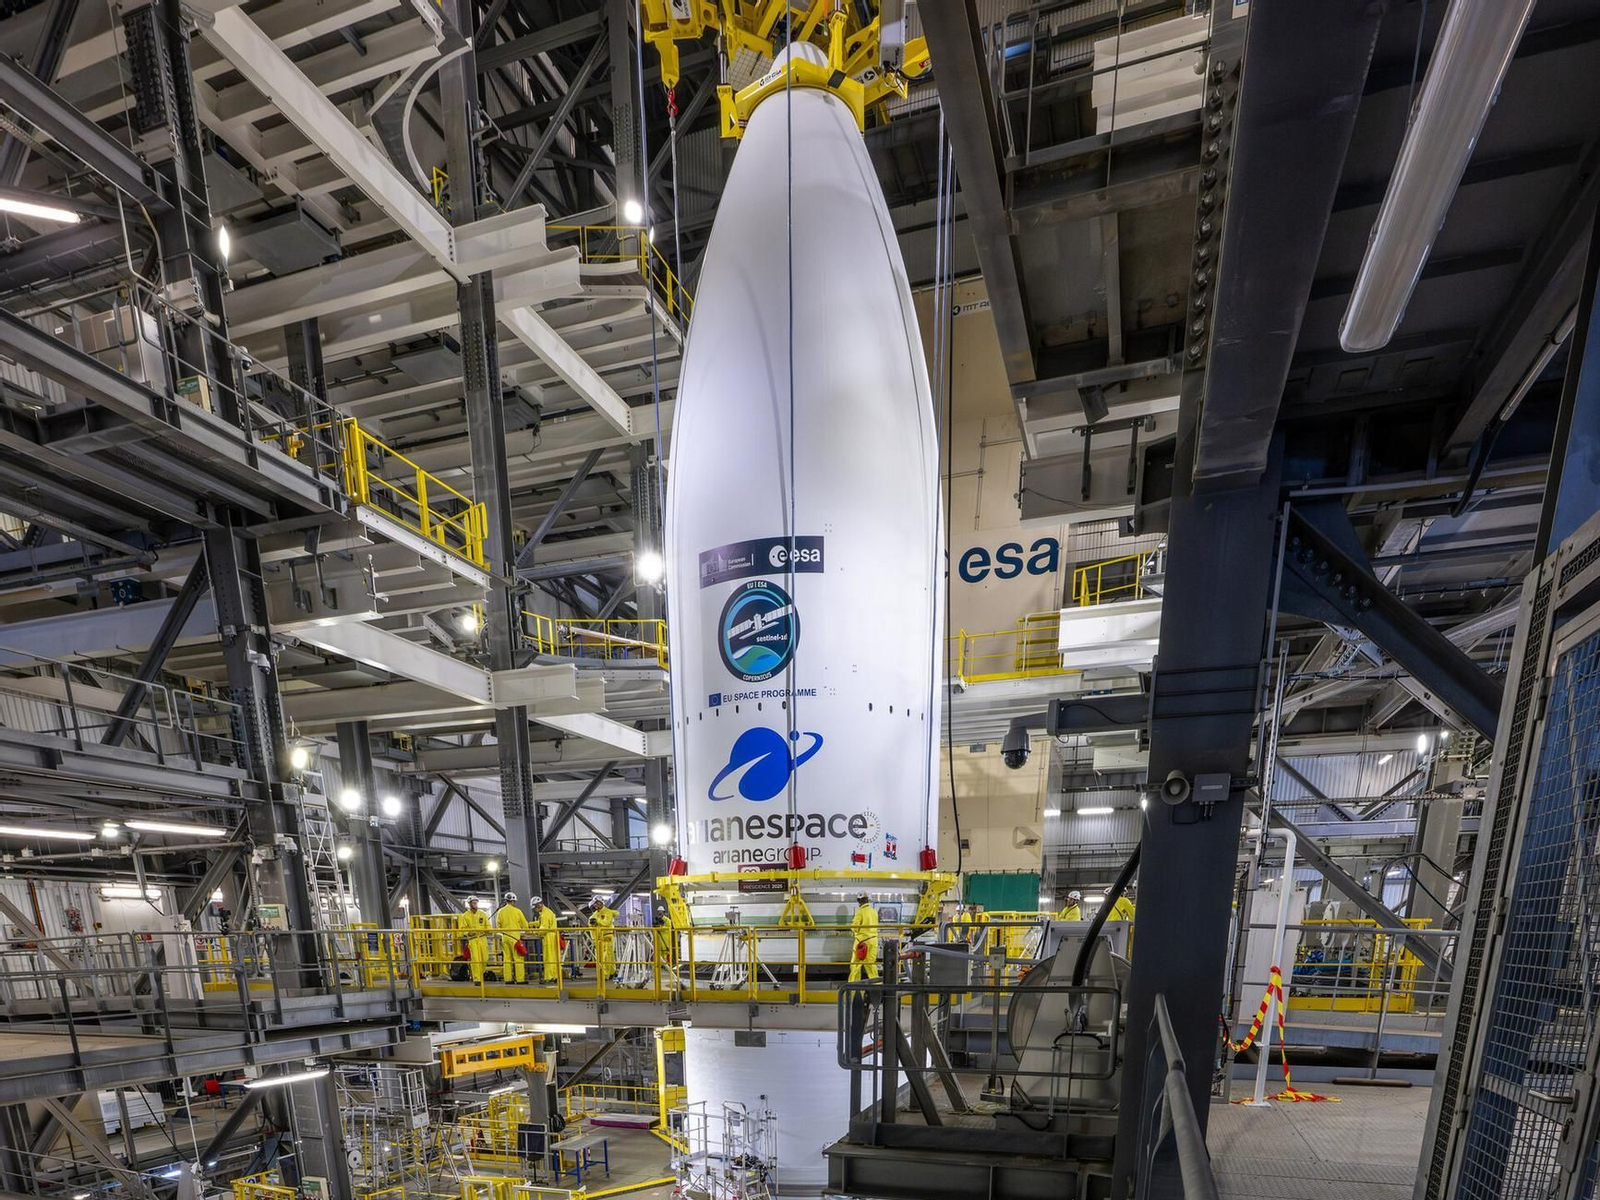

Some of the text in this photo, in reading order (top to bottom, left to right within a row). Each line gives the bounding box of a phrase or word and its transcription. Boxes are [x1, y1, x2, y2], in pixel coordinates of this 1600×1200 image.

[789, 548, 821, 562] esa
[958, 537, 1060, 584] esa
[742, 671, 772, 681] COPERNICUS
[723, 688, 817, 703] EU SPACE PROGRAMME
